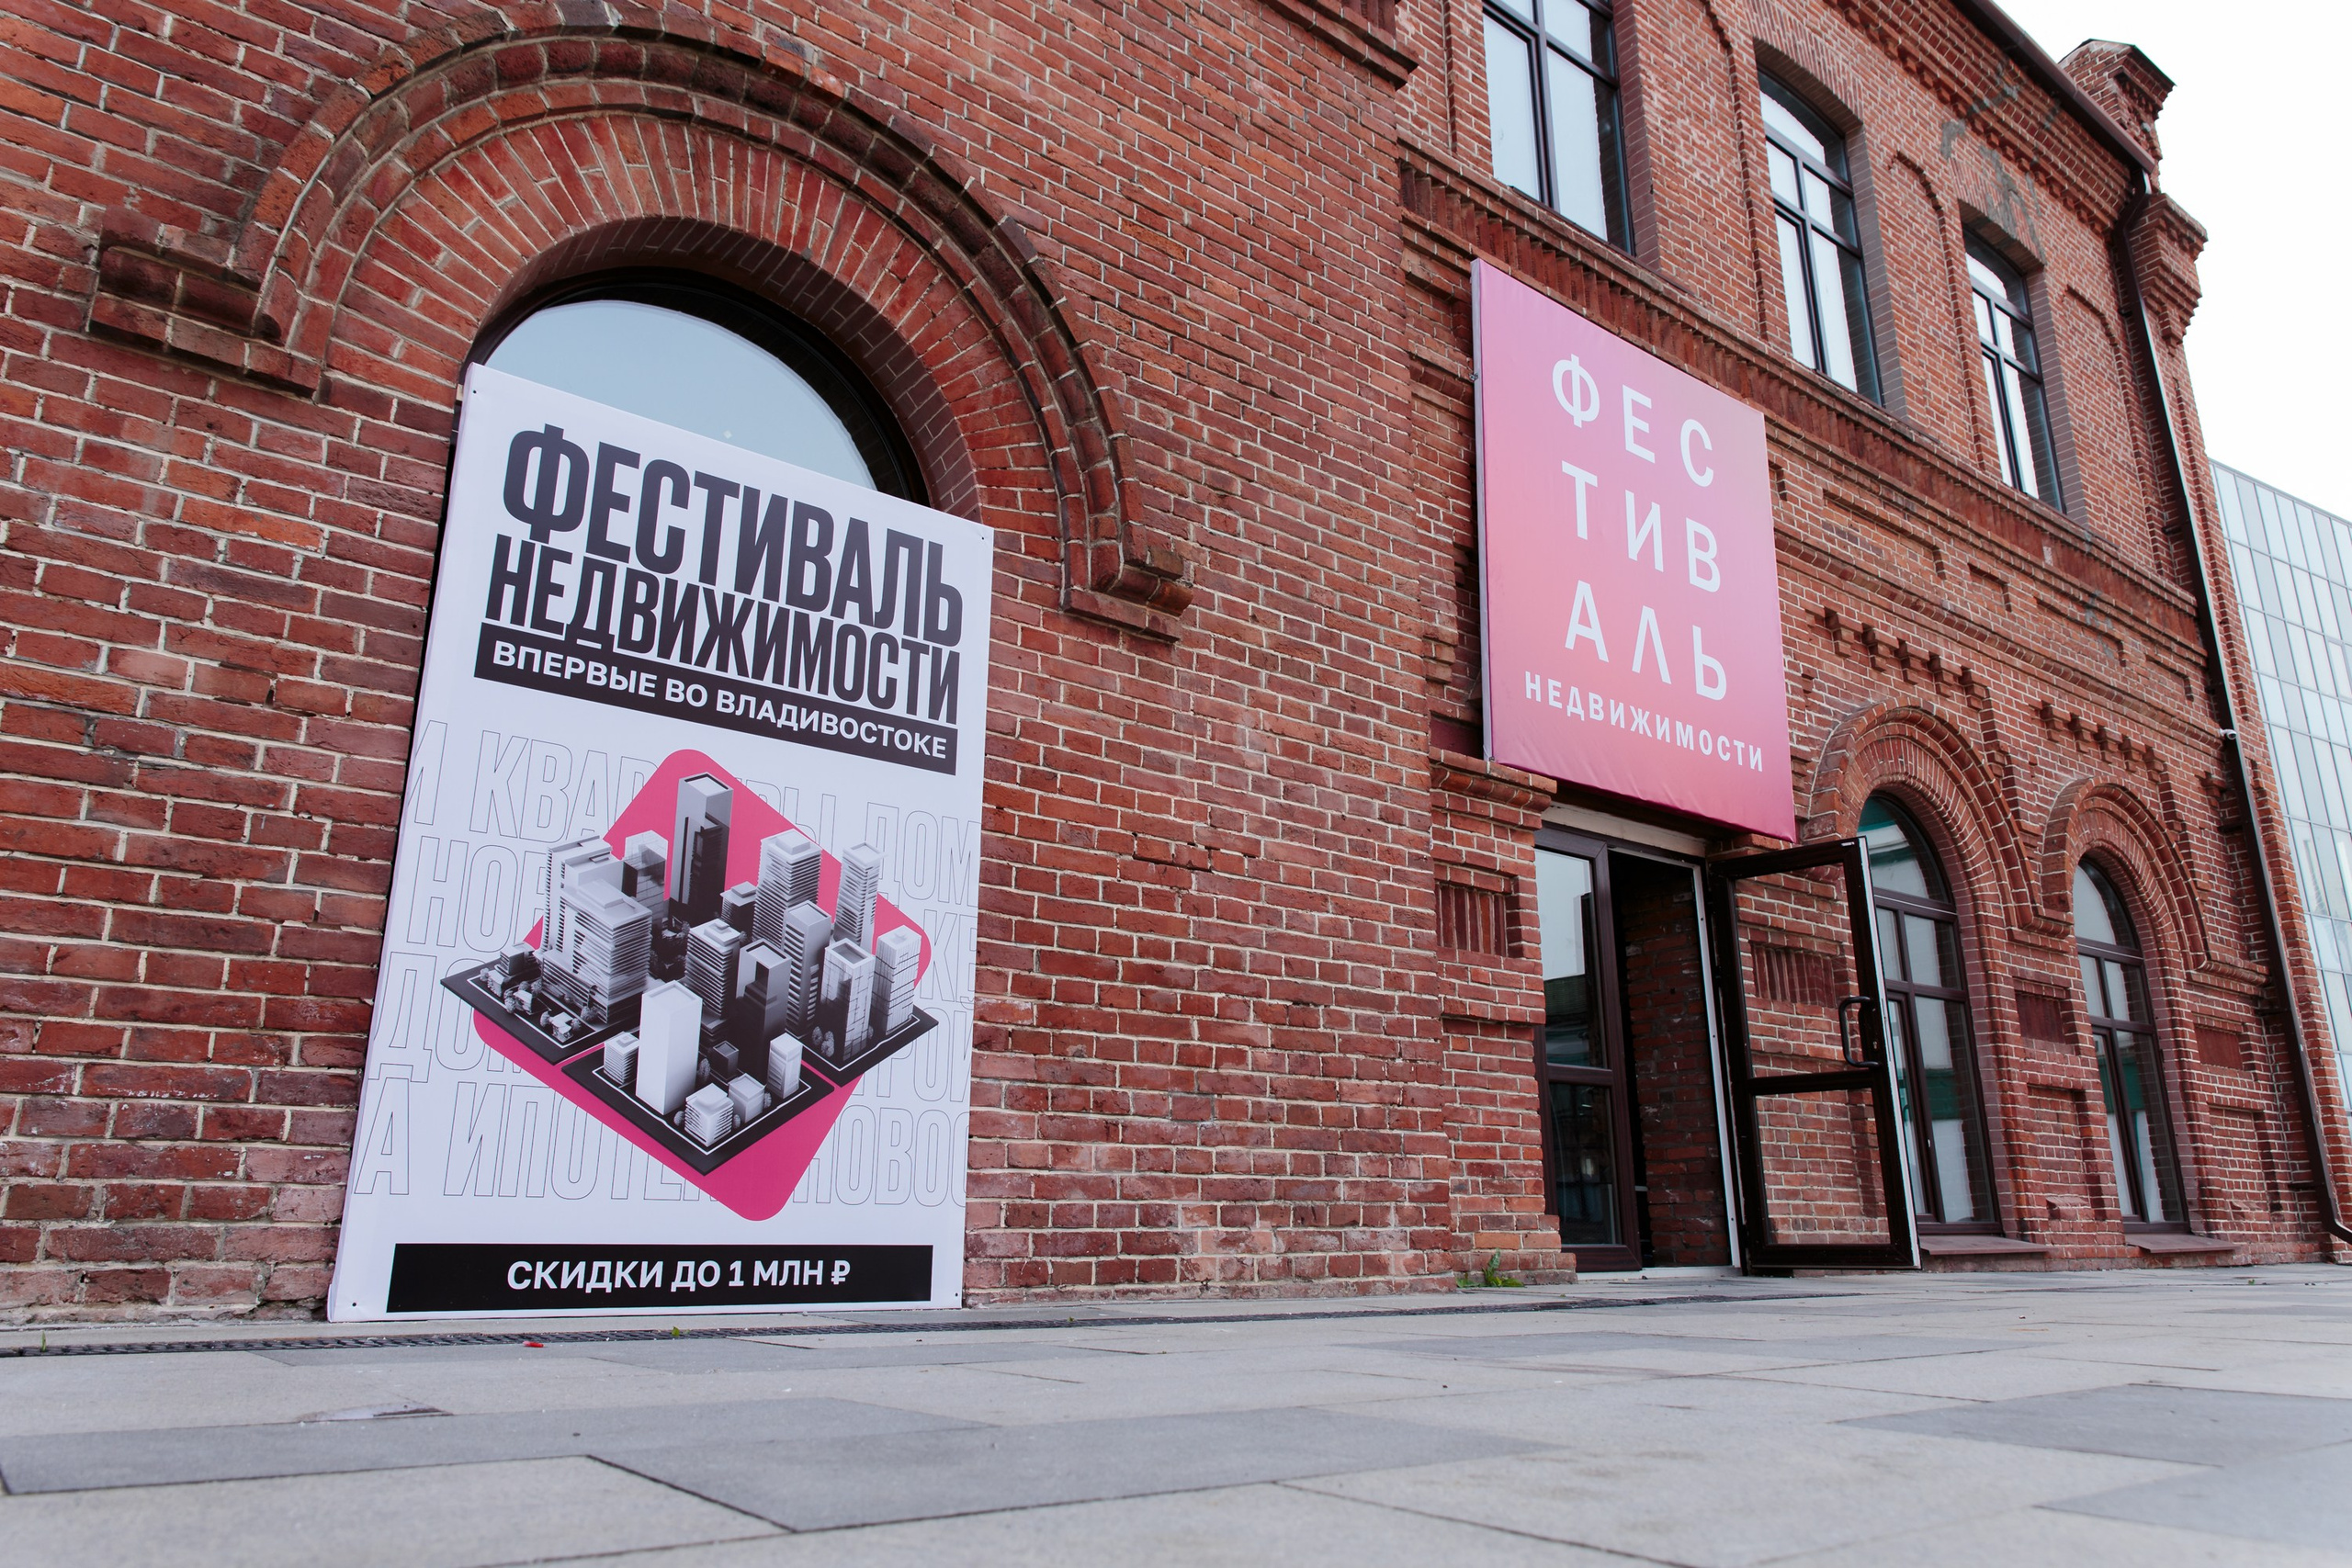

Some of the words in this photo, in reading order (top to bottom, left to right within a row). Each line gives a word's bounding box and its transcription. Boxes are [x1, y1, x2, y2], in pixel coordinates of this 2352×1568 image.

[1552, 352, 1715, 489] ФЕС
[503, 423, 963, 648] ФЕСТИВАЛЬ
[1561, 460, 1722, 593] ТИВ
[485, 533, 960, 726] НЕДВИЖИМОСТИ
[1565, 580, 1727, 701] АЛЬ
[492, 639, 658, 698] ВПЕРВЫЕ
[664, 678, 708, 707] ВО
[716, 689, 947, 760] ВЛАДИВОСТОКЕ
[1524, 671, 1763, 773] НЕДВИЖИМОСТИ
[507, 1260, 663, 1293] СКИДКИ
[670, 1260, 721, 1292] ДО
[728, 1260, 744, 1287] 1
[752, 1259, 824, 1287] МЛН
